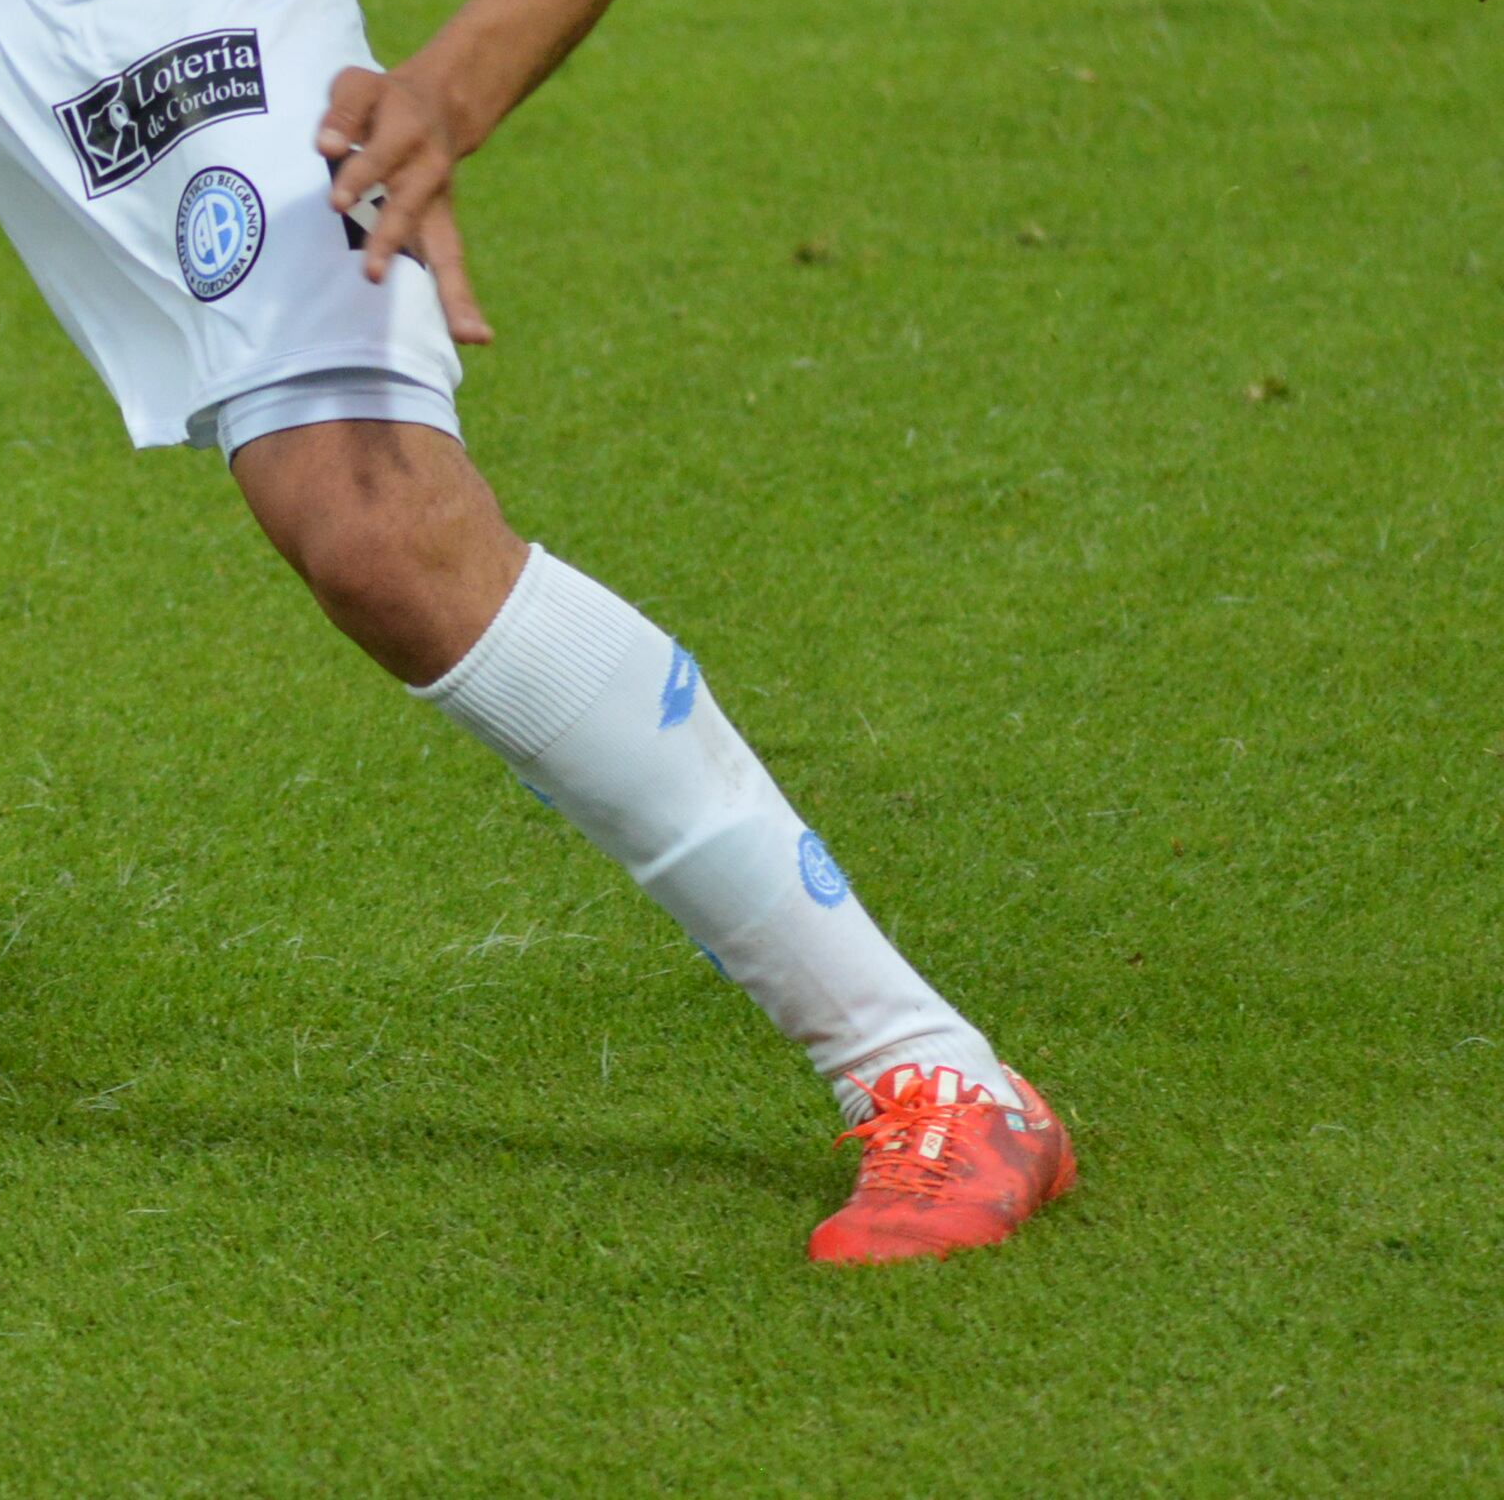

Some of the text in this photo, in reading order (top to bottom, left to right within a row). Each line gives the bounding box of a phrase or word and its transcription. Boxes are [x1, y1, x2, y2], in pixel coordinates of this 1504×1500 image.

[132, 37, 257, 108] Lotería
[147, 77, 260, 139] de Córdoba
[217, 174, 258, 238] BELGRANO
